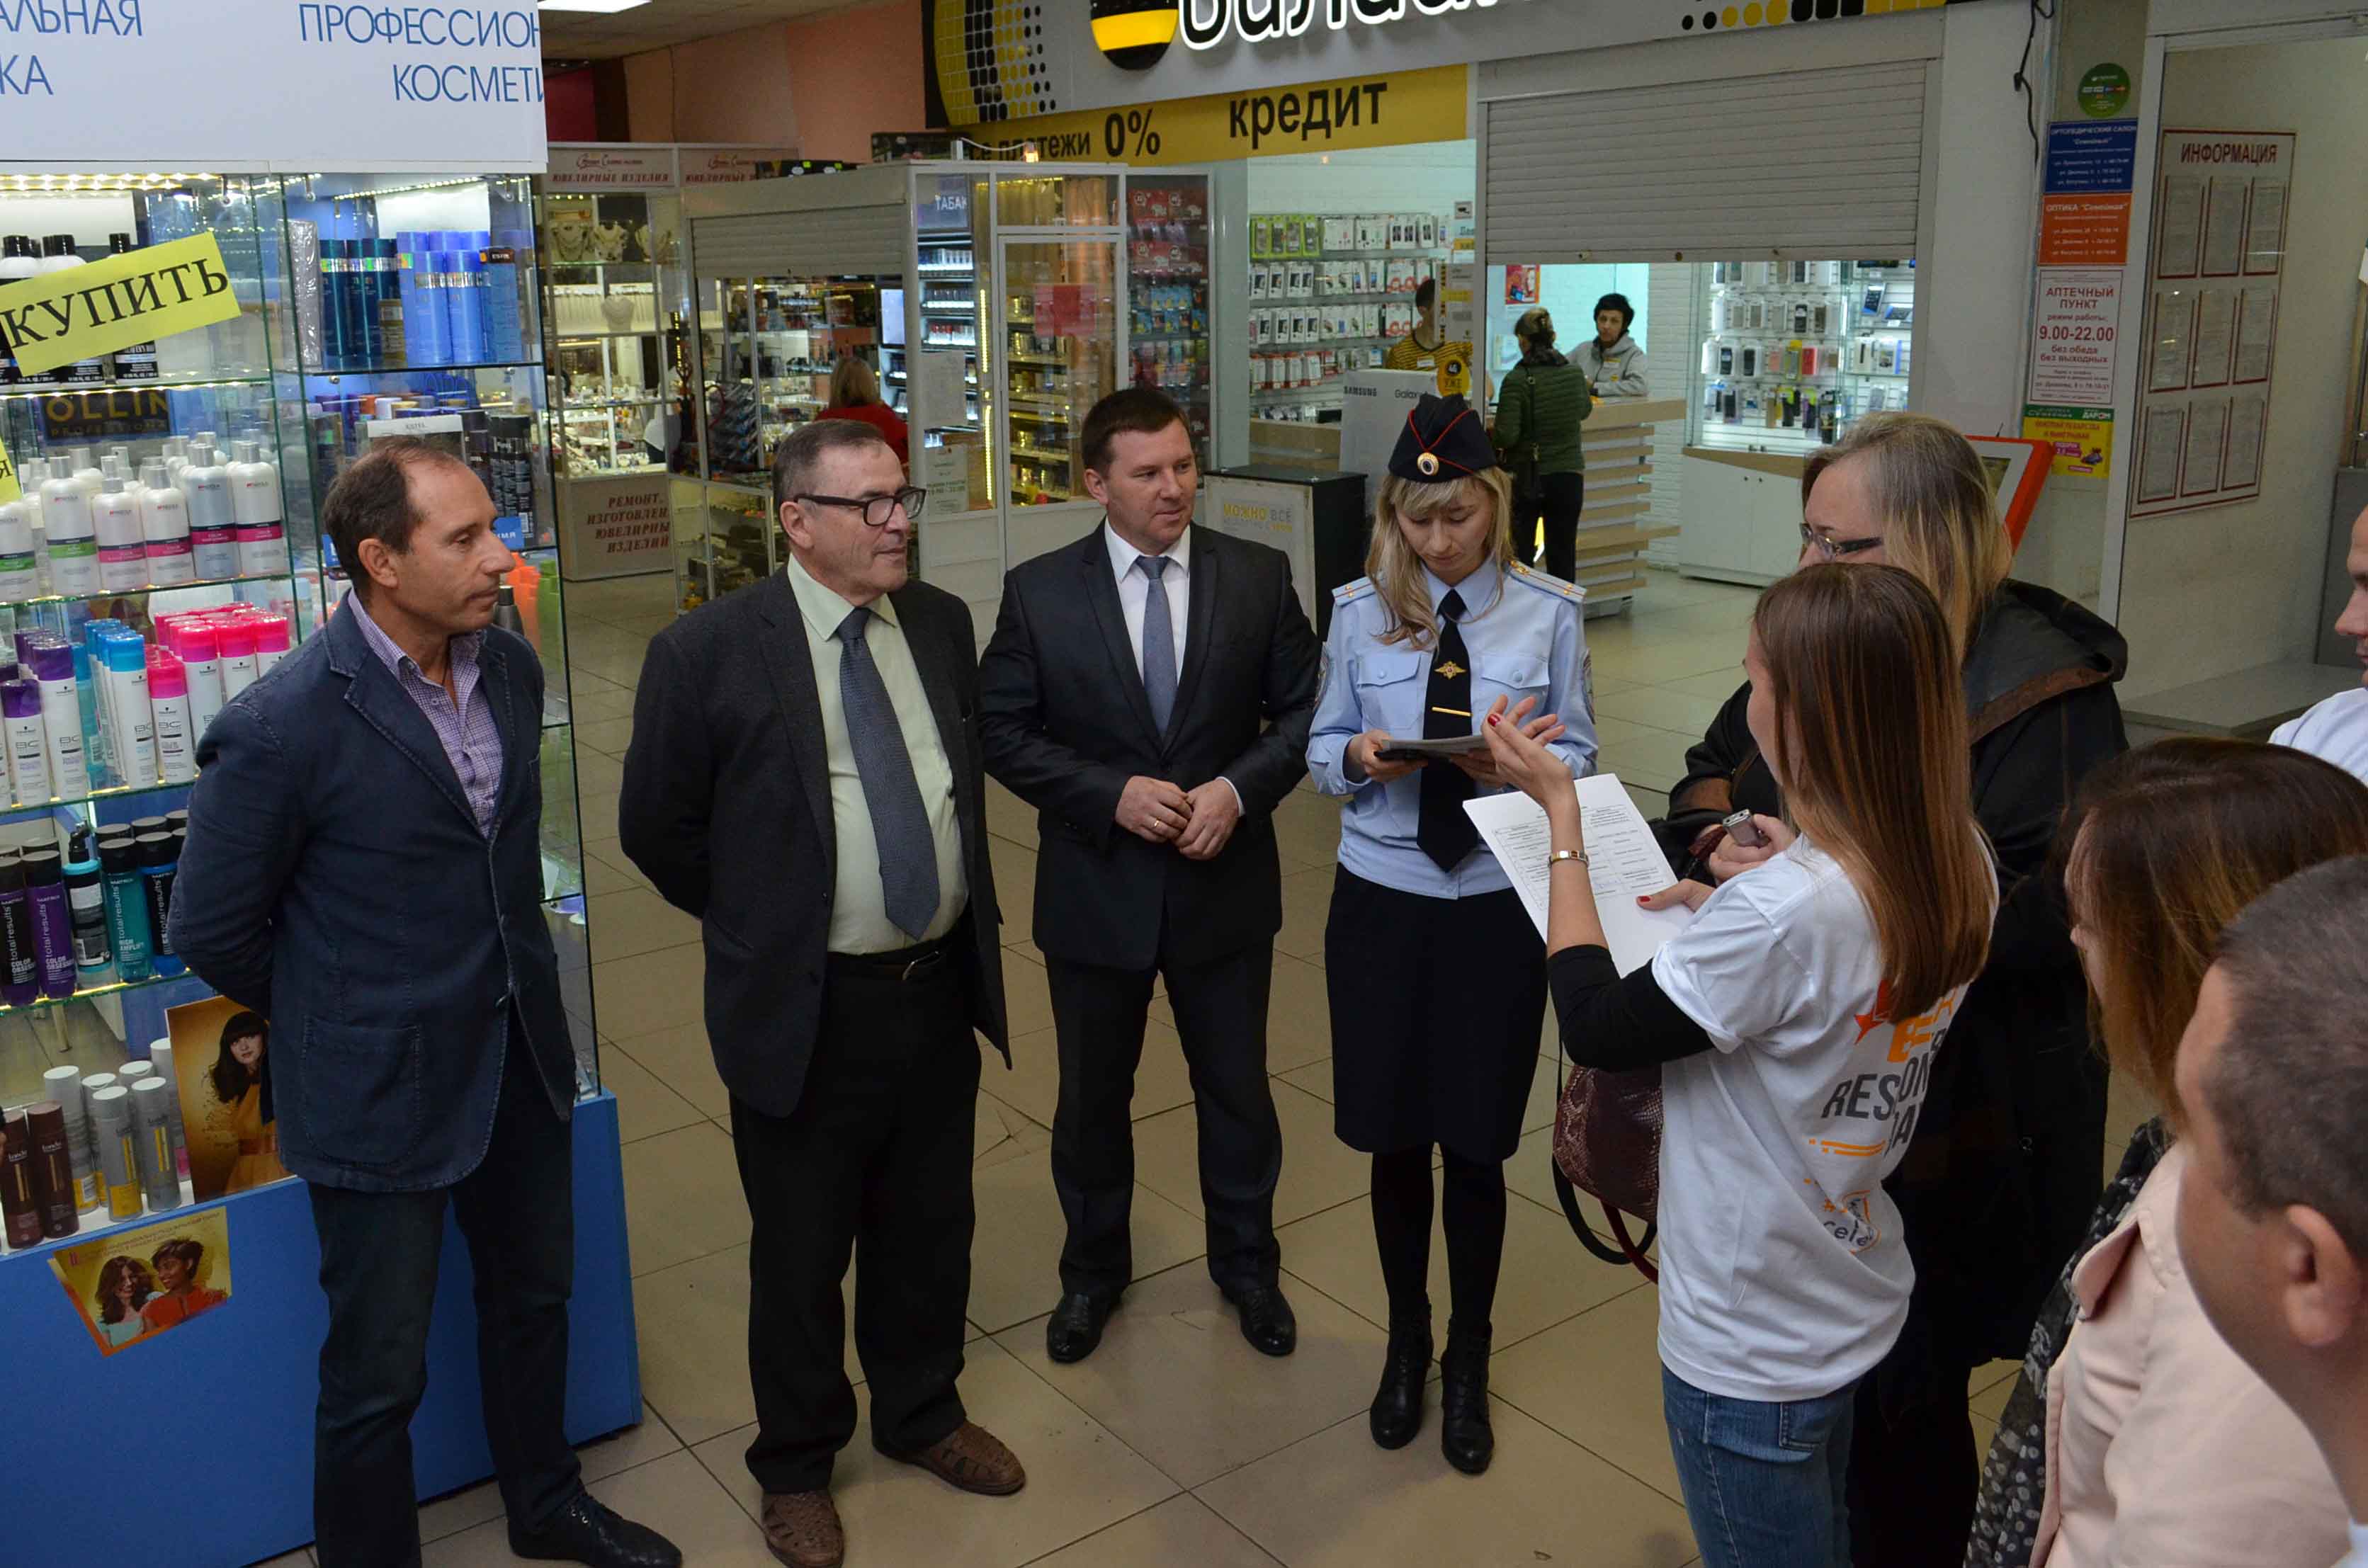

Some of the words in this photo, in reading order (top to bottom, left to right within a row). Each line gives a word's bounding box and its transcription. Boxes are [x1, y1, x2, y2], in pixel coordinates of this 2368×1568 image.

[1229, 81, 1388, 150] кредит
[1105, 108, 1161, 157] 0%
[2181, 143, 2278, 166] ИНФОРМАЦИЯ
[553, 174, 616, 182] ЮВЕЛИРНЫЕ
[622, 173, 669, 182] ИЗДЕЛИЯ
[2046, 285, 2114, 297] АПТЕЧНЫЙ
[0, 258, 228, 348] КУПИТЬ
[2060, 300, 2098, 309] ПУНКТ
[2039, 325, 2114, 341] 9.00-22.00
[2051, 345, 2067, 353] без
[2069, 345, 2098, 354] обеда
[1344, 385, 1378, 397] SAMSUNG
[1394, 389, 1421, 399] Galax
[607, 535, 669, 553] ИЗДЕЛИЙ
